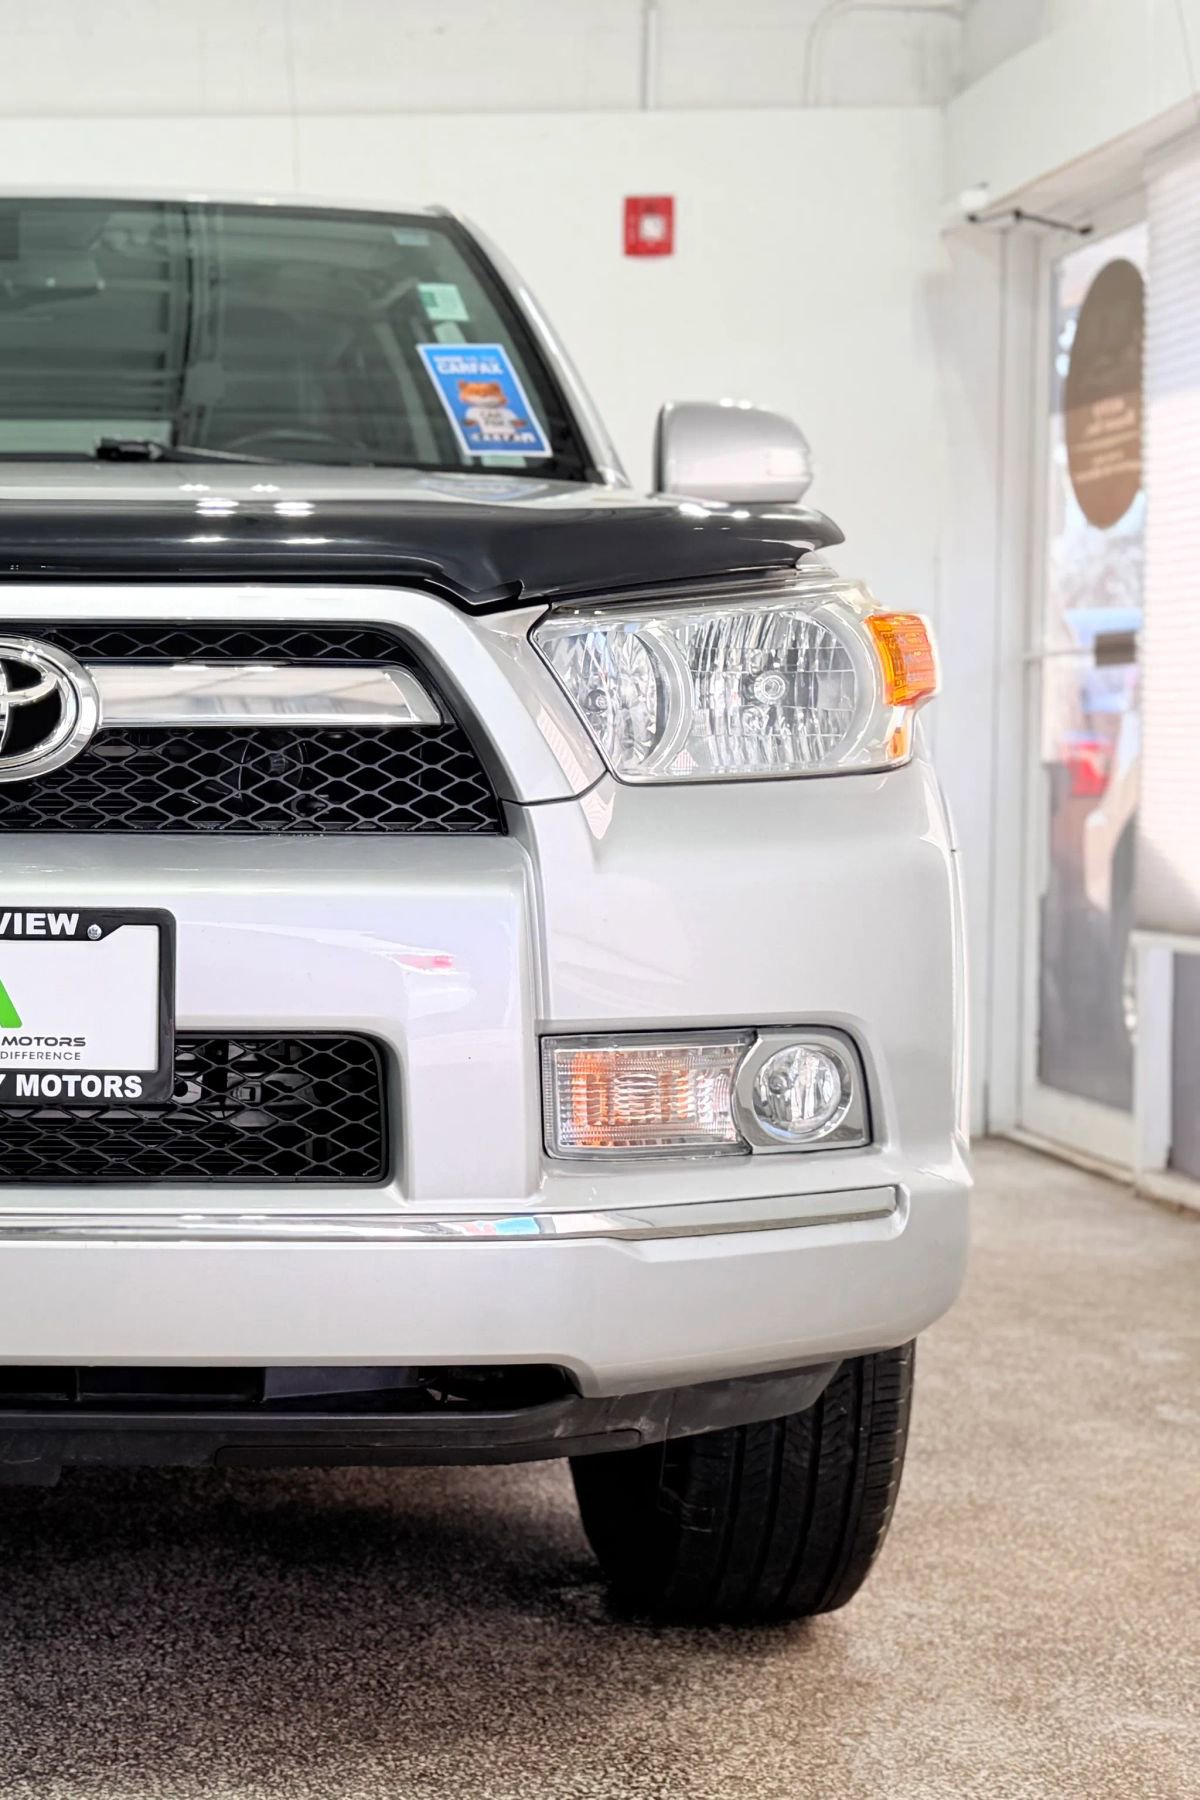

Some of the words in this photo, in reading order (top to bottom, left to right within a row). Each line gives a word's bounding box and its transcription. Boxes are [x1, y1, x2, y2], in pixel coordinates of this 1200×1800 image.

[1, 1036, 87, 1047] MOTORS
[0, 1051, 82, 1061] DIFFERENCE
[15, 1073, 143, 1099] MOTORS
